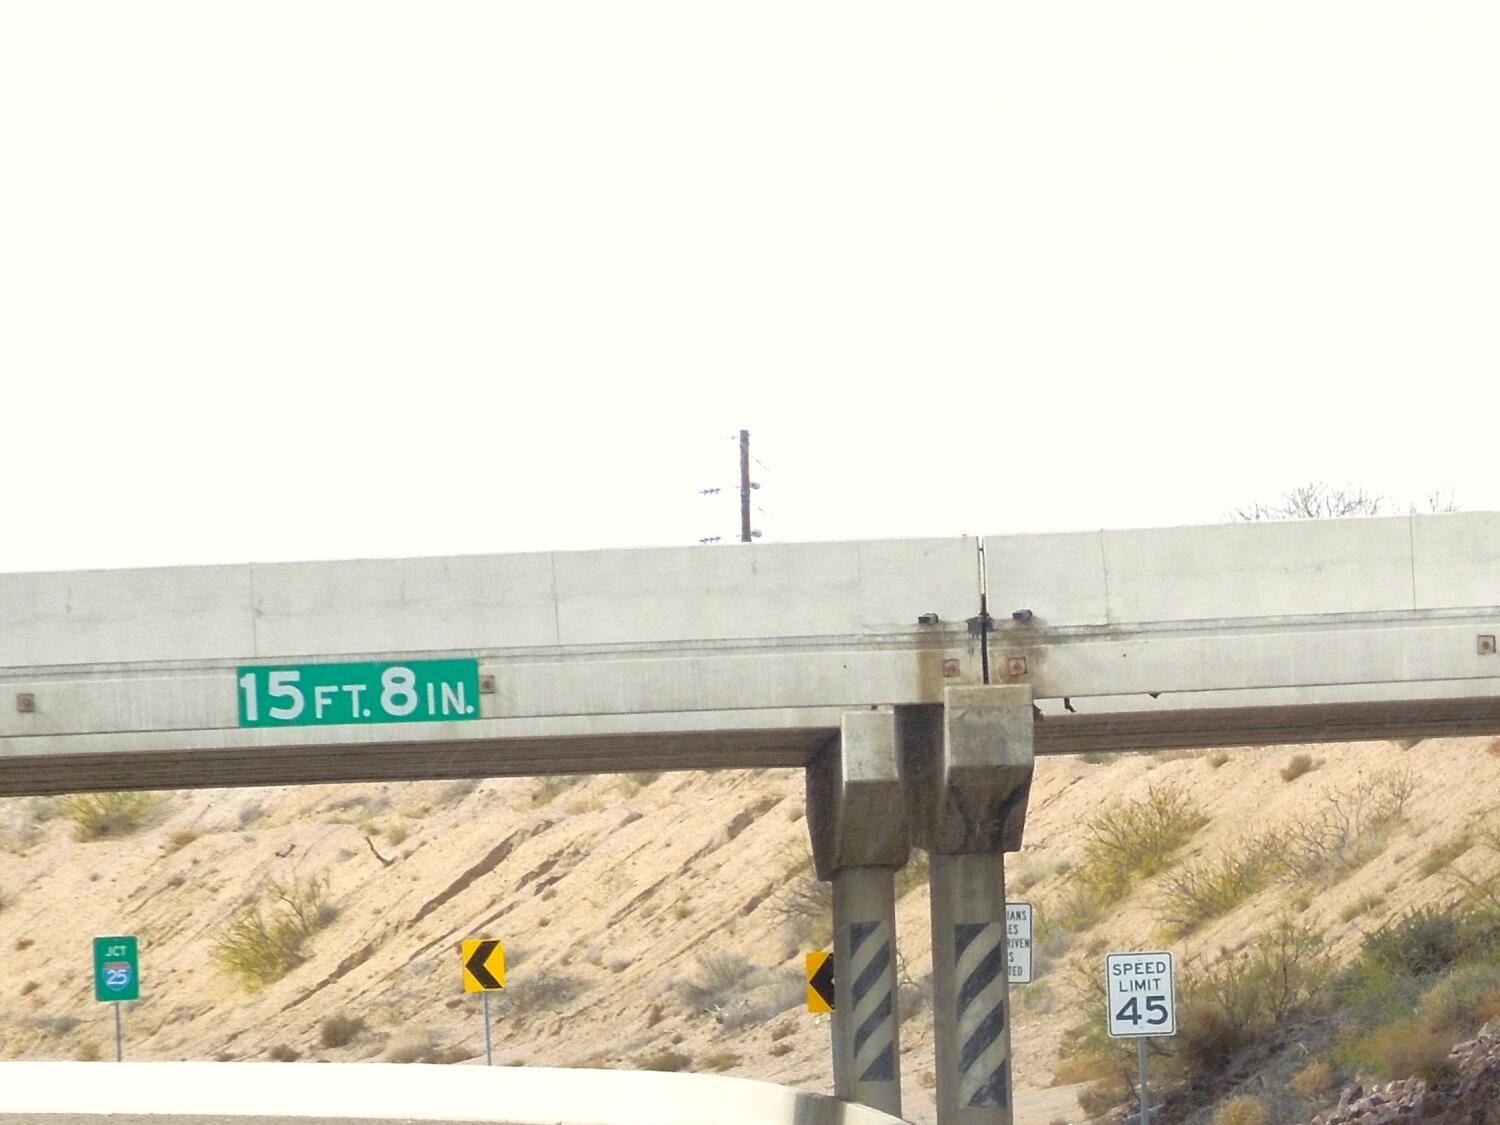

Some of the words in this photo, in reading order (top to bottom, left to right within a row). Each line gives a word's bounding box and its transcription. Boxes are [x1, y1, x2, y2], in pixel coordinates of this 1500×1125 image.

[239, 670, 304, 721] 15
[314, 684, 371, 718] FT.
[380, 666, 418, 716] 8
[427, 682, 474, 715] IN.
[104, 945, 128, 957] JCT
[106, 968, 128, 985] 25
[1112, 961, 1166, 976] SPEED
[1119, 978, 1162, 992] LIMIT
[1115, 995, 1169, 1025] 45
